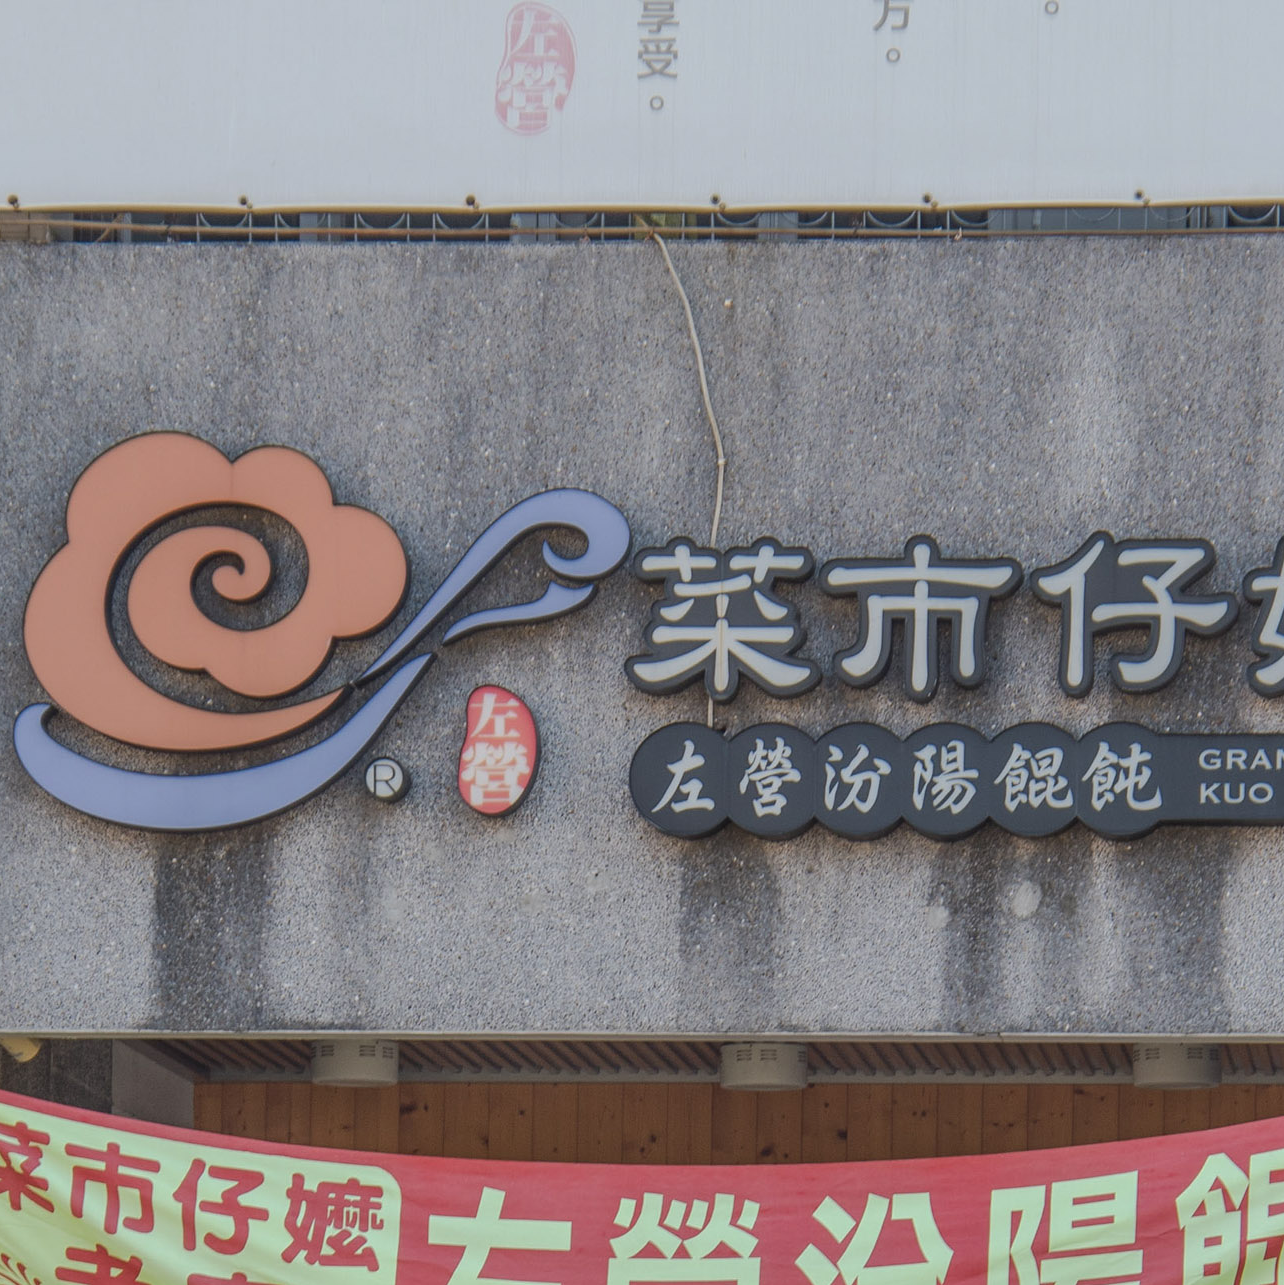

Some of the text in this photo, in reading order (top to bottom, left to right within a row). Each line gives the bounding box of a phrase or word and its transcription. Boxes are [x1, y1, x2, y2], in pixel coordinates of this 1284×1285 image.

[461, 692, 531, 806] 左營
[651, 738, 1163, 817] 左營汾陽餛飩
[1199, 781, 1274, 805] KUO
